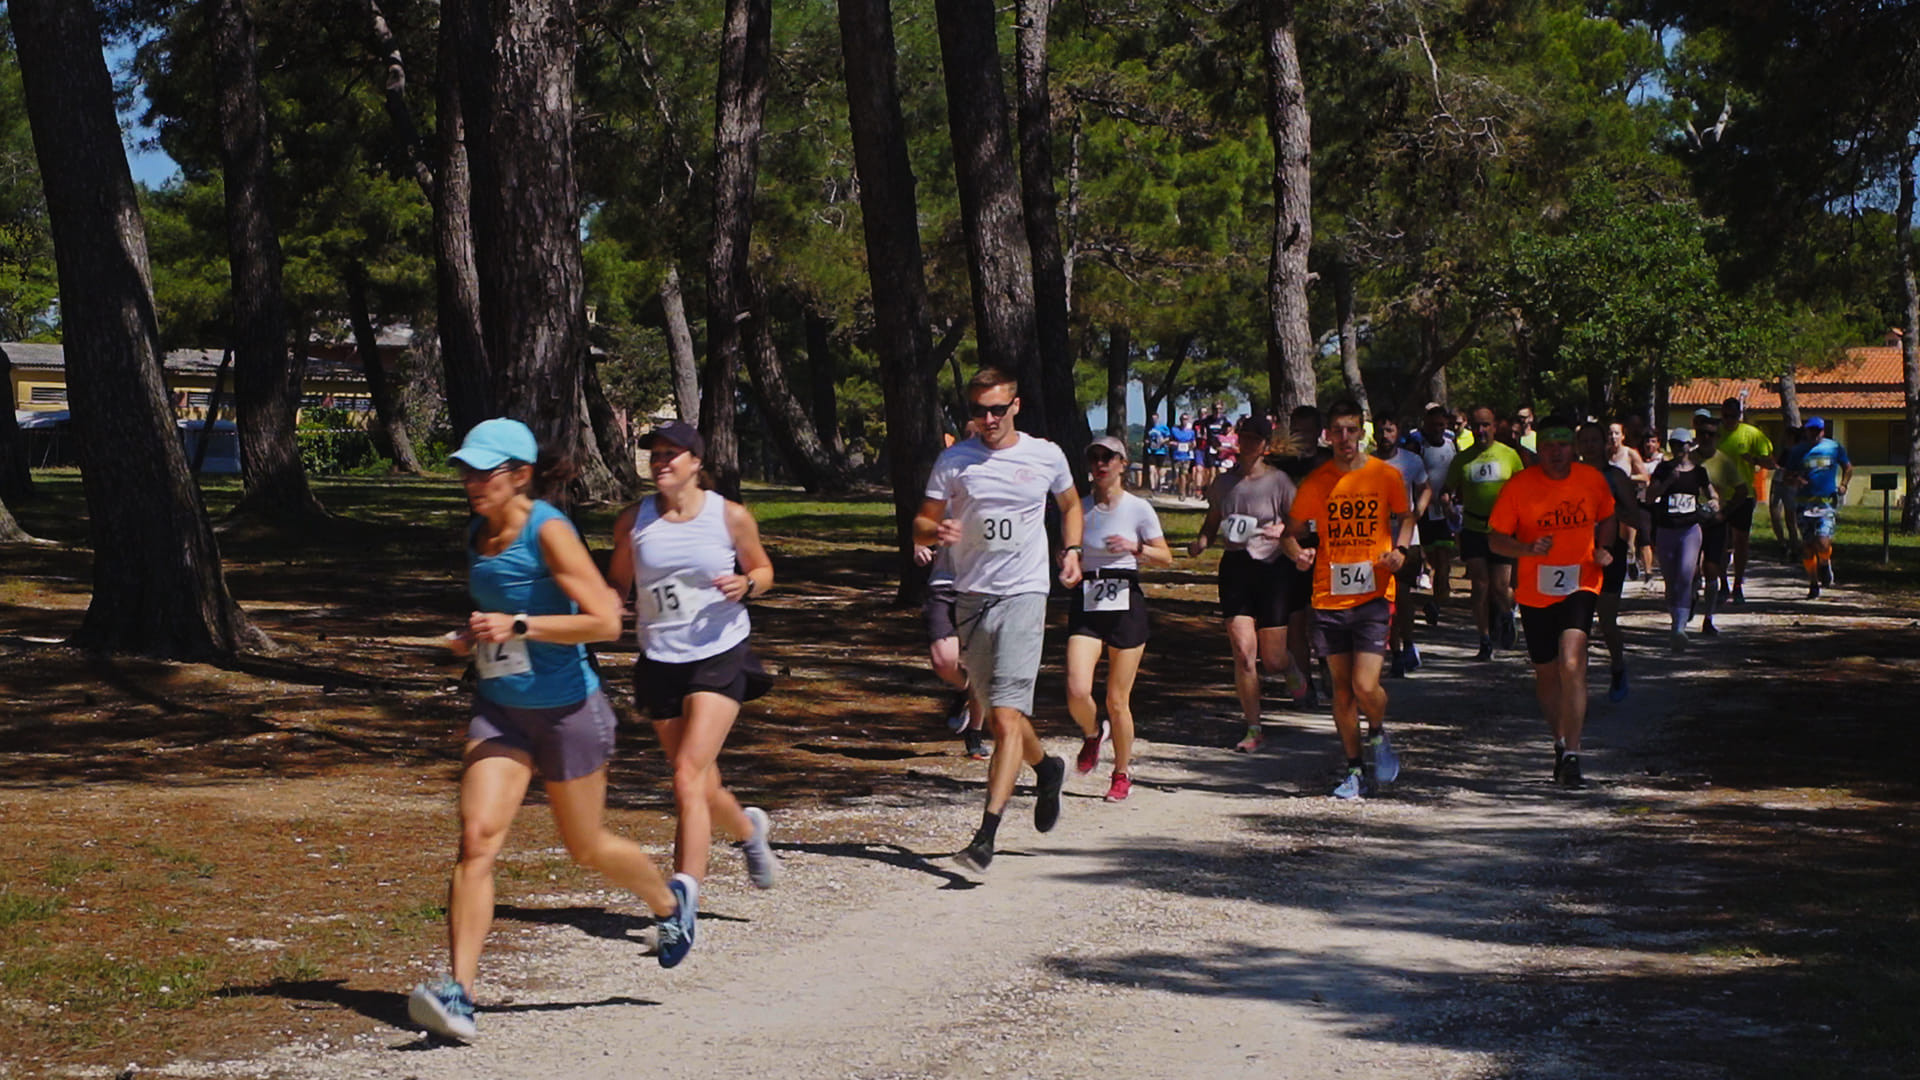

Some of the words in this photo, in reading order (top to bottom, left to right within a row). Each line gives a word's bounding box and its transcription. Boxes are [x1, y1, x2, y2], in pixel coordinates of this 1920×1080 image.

[1479, 464, 1492, 476] 61
[1328, 500, 1378, 521] 2022
[983, 518, 1013, 541] 30
[1228, 517, 1246, 534] 70
[1328, 521, 1378, 538] HALF
[1340, 567, 1366, 586] 54
[1553, 570, 1566, 588] 2
[652, 584, 680, 613] 15
[1094, 582, 1118, 602] 28
